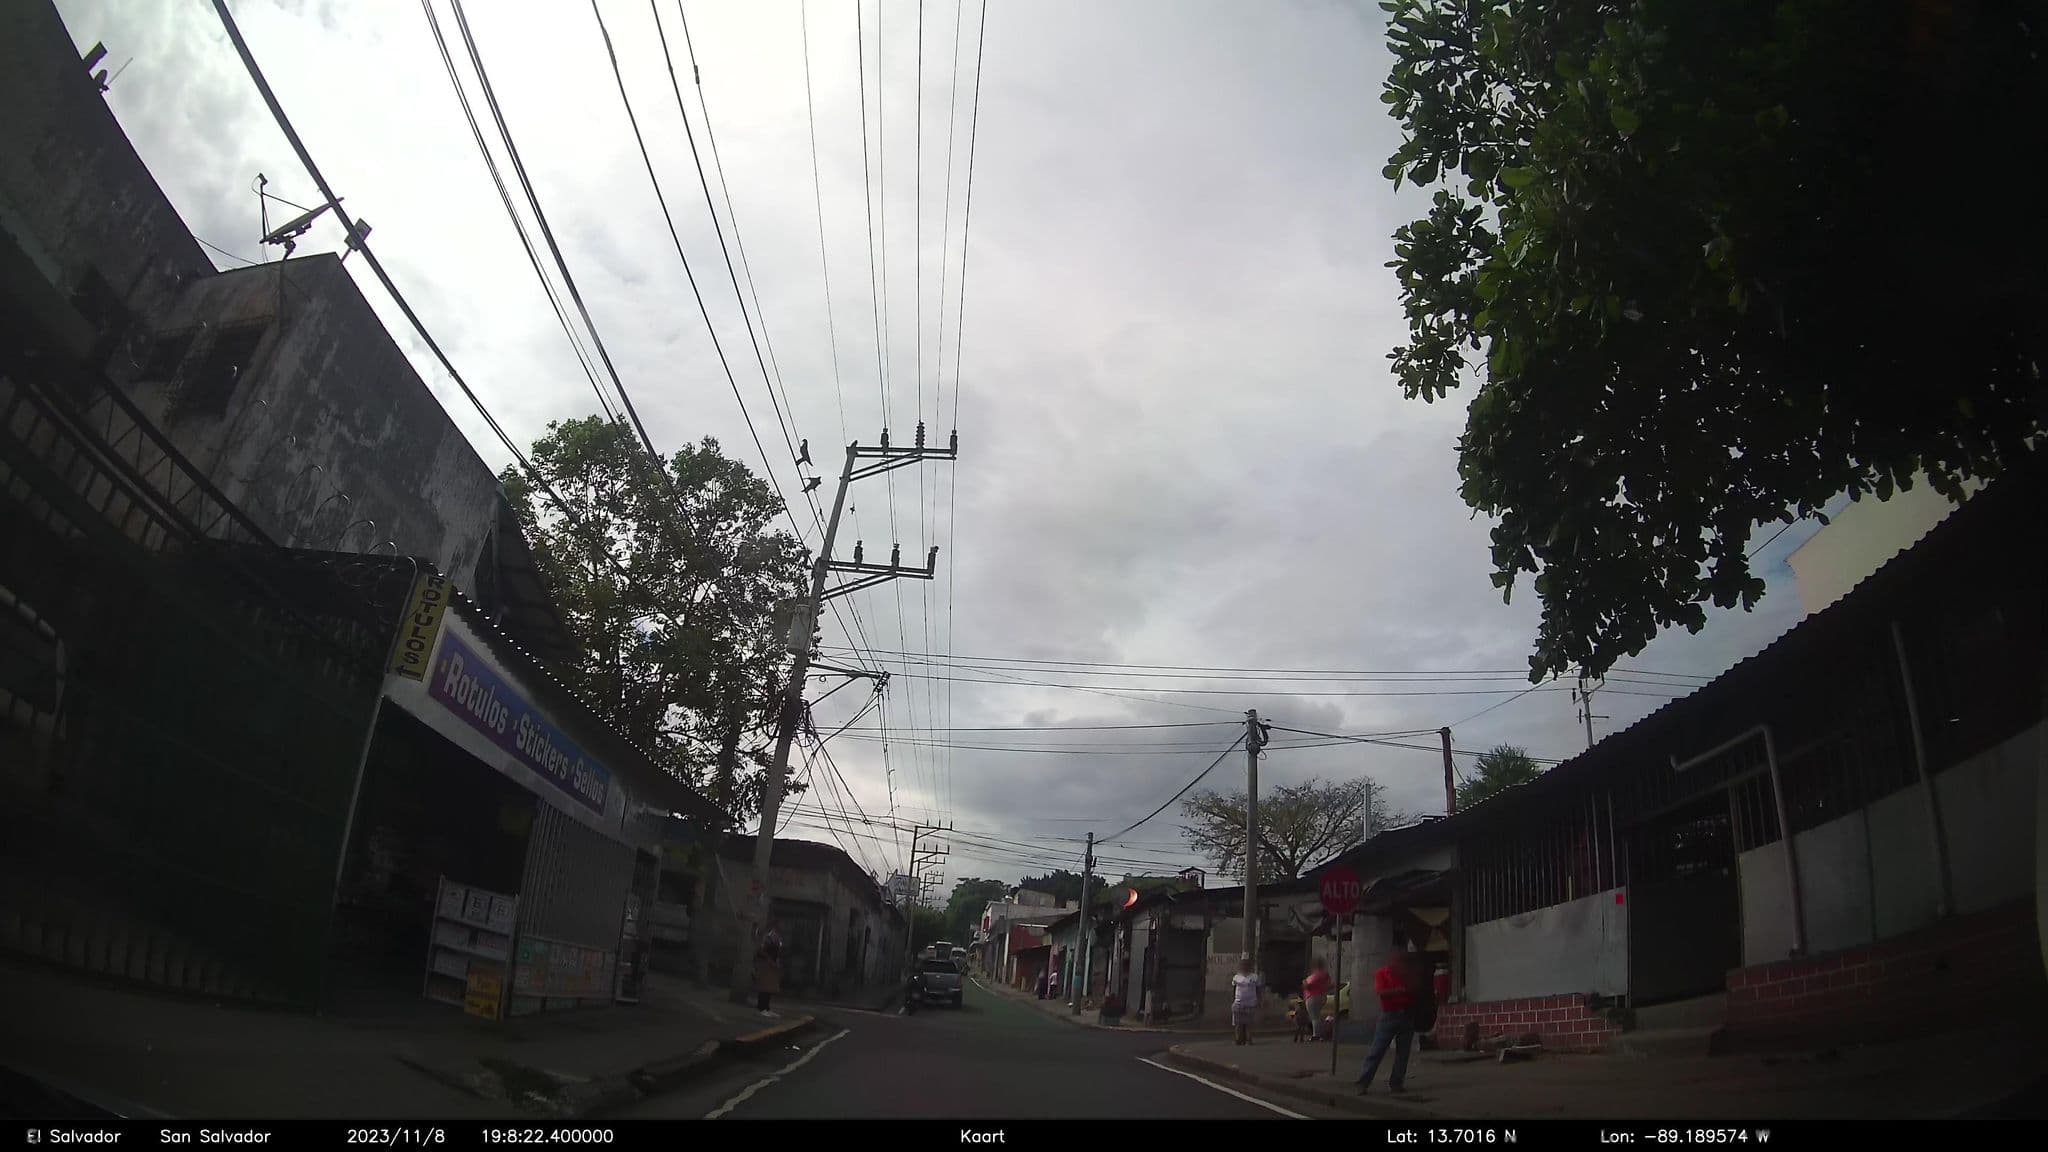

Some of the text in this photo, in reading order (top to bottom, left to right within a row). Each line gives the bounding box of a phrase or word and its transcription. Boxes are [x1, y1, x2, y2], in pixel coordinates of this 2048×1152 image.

[404, 574, 446, 666] ROTULOS
[443, 652, 605, 805] Rotulos Stickers Sellos
[1322, 880, 1360, 900] ALTO
